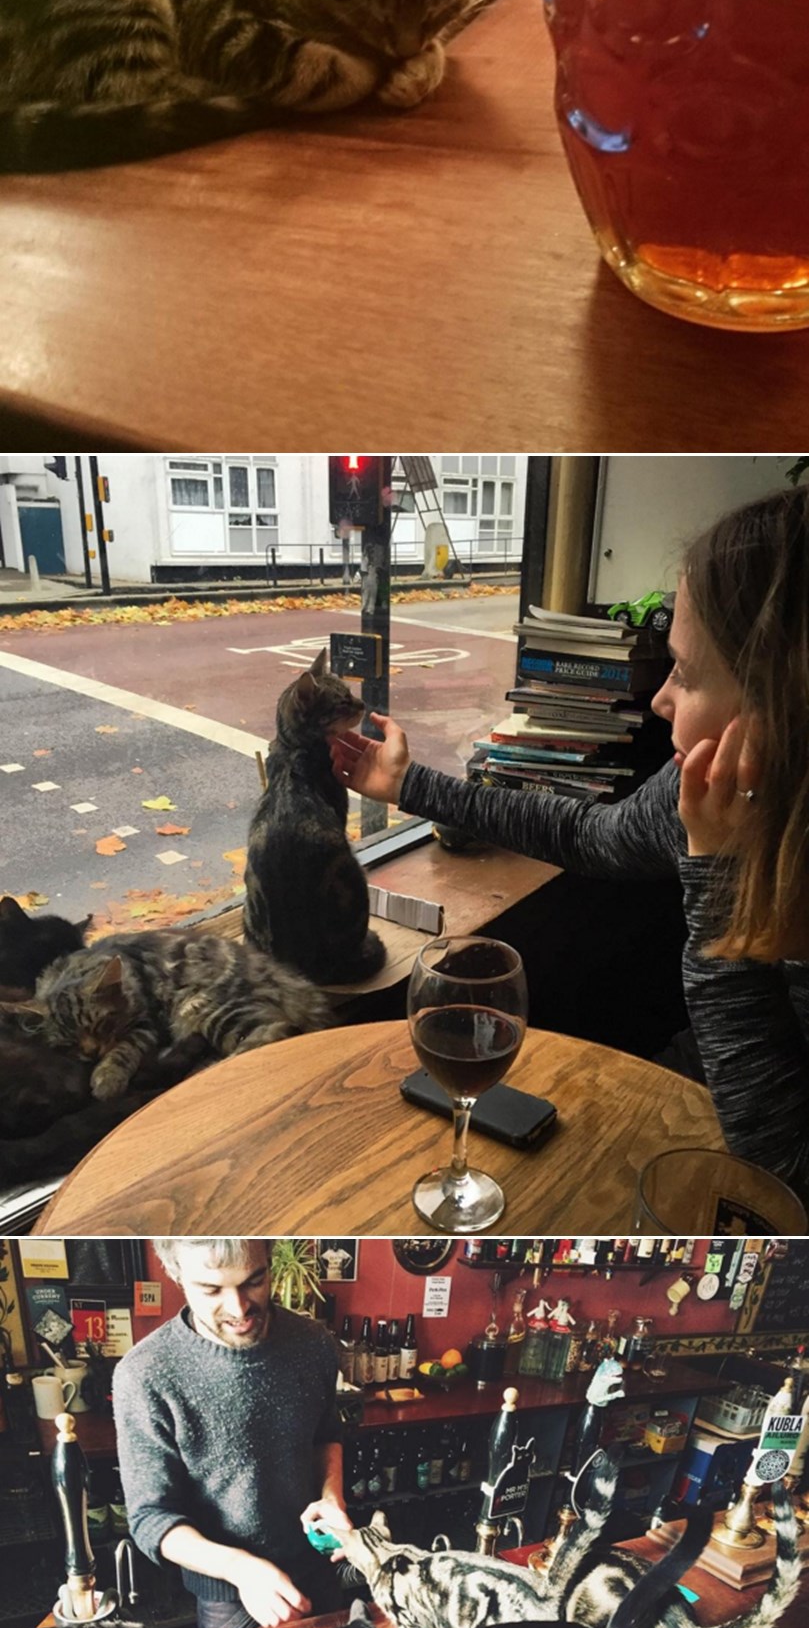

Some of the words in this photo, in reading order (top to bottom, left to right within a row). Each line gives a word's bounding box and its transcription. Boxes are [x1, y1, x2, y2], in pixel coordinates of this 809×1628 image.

[521, 781, 555, 794] BEERS
[84, 1315, 104, 1340] 13
[767, 1416, 803, 1432] KUBLA
